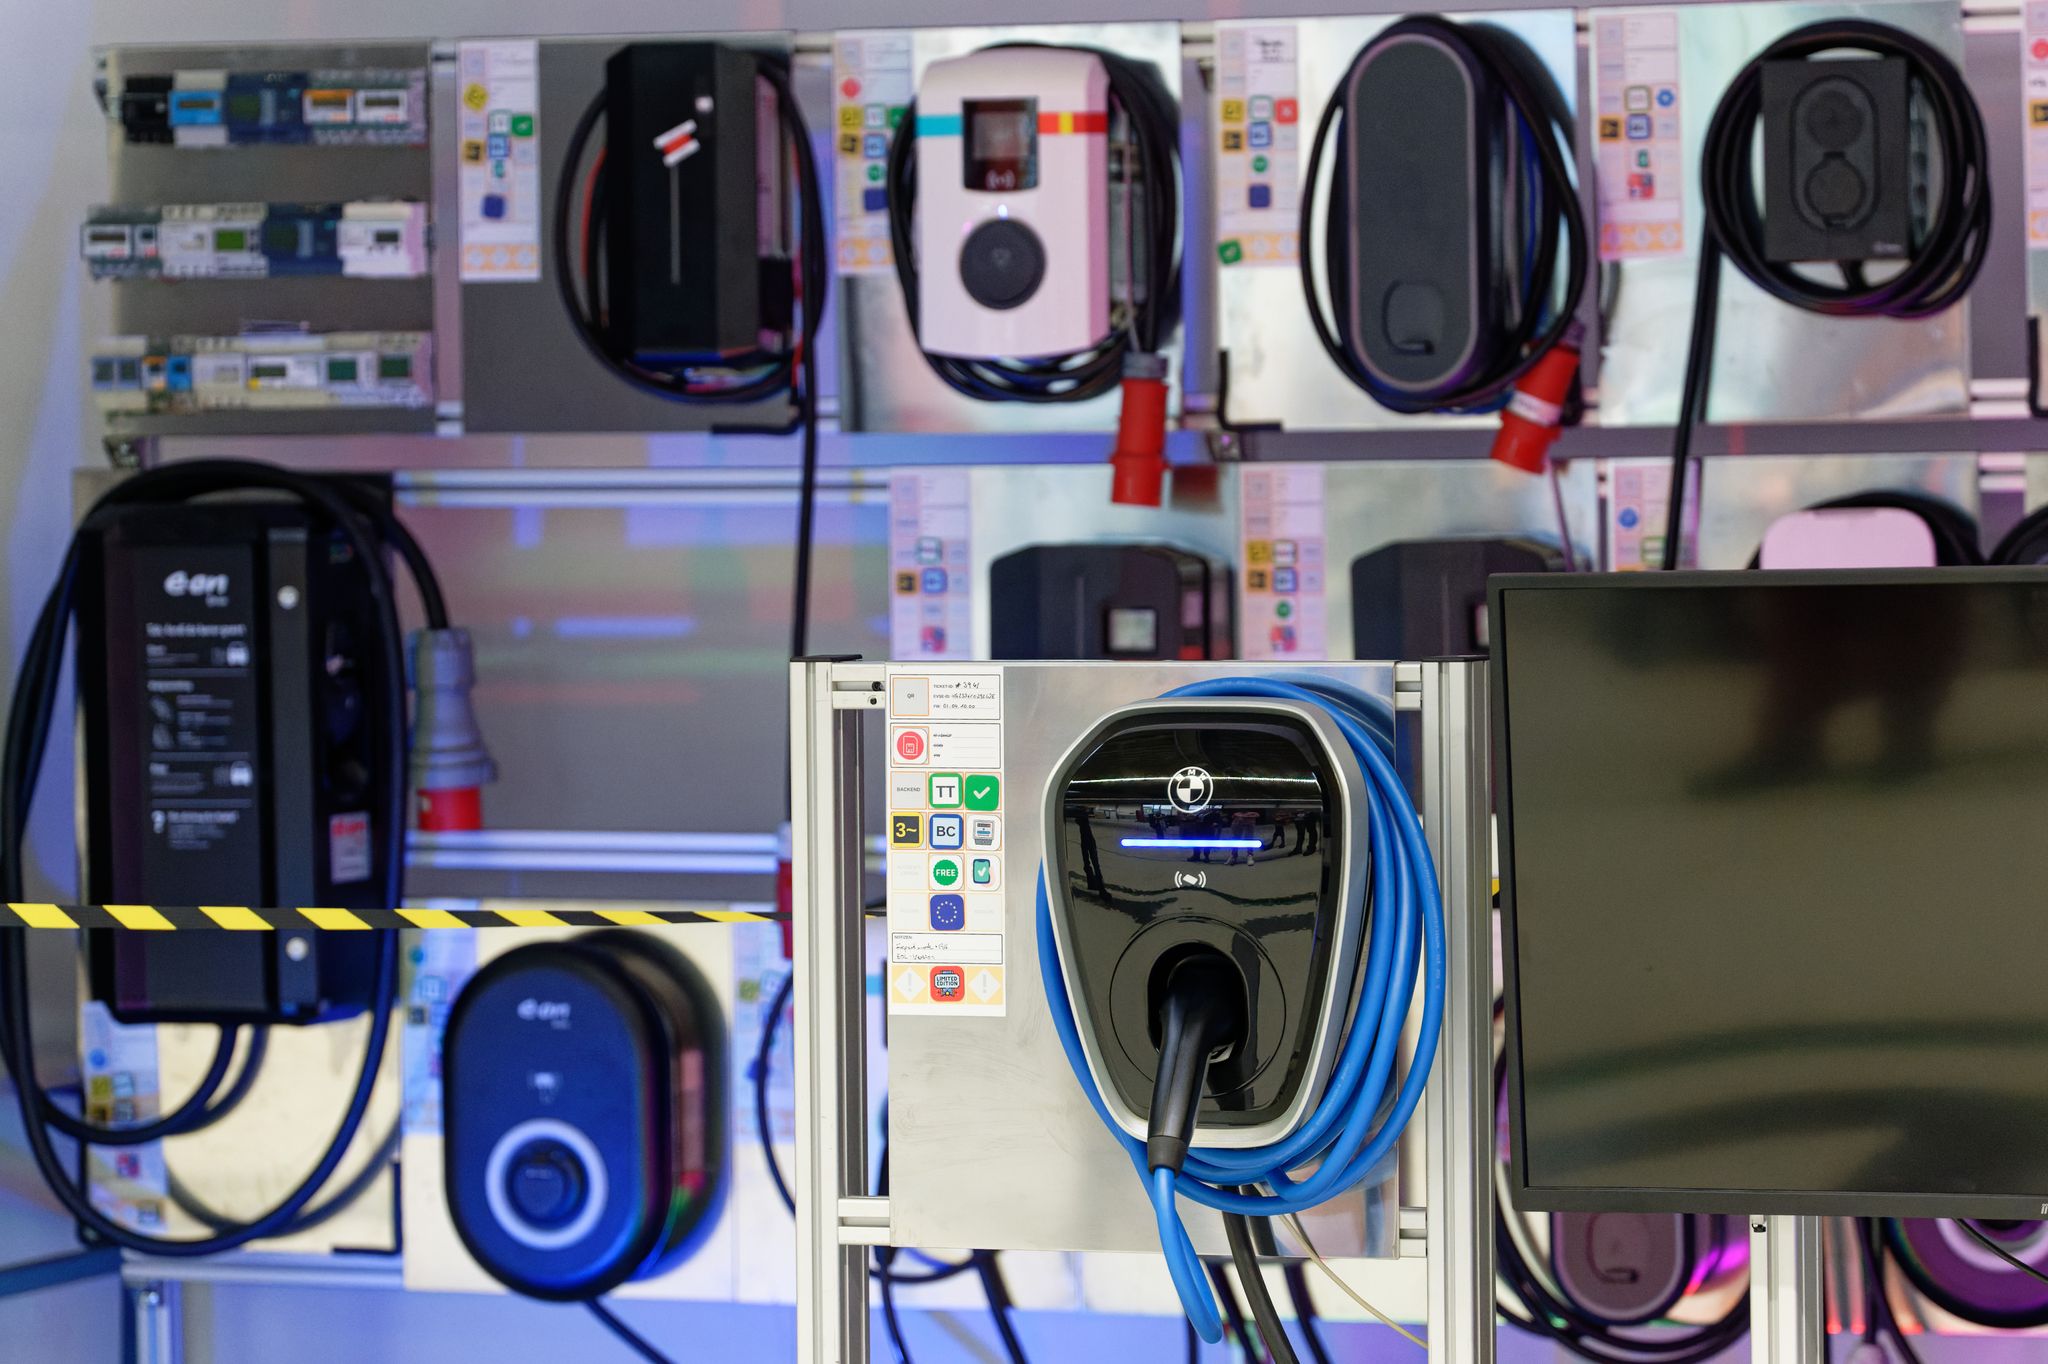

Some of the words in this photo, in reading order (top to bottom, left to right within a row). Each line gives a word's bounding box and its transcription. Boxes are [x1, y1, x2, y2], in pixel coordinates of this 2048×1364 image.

[1174, 768, 1209, 781] BMW
[935, 785, 956, 798] TT
[936, 826, 956, 837] BC
[935, 868, 956, 877] FREE
